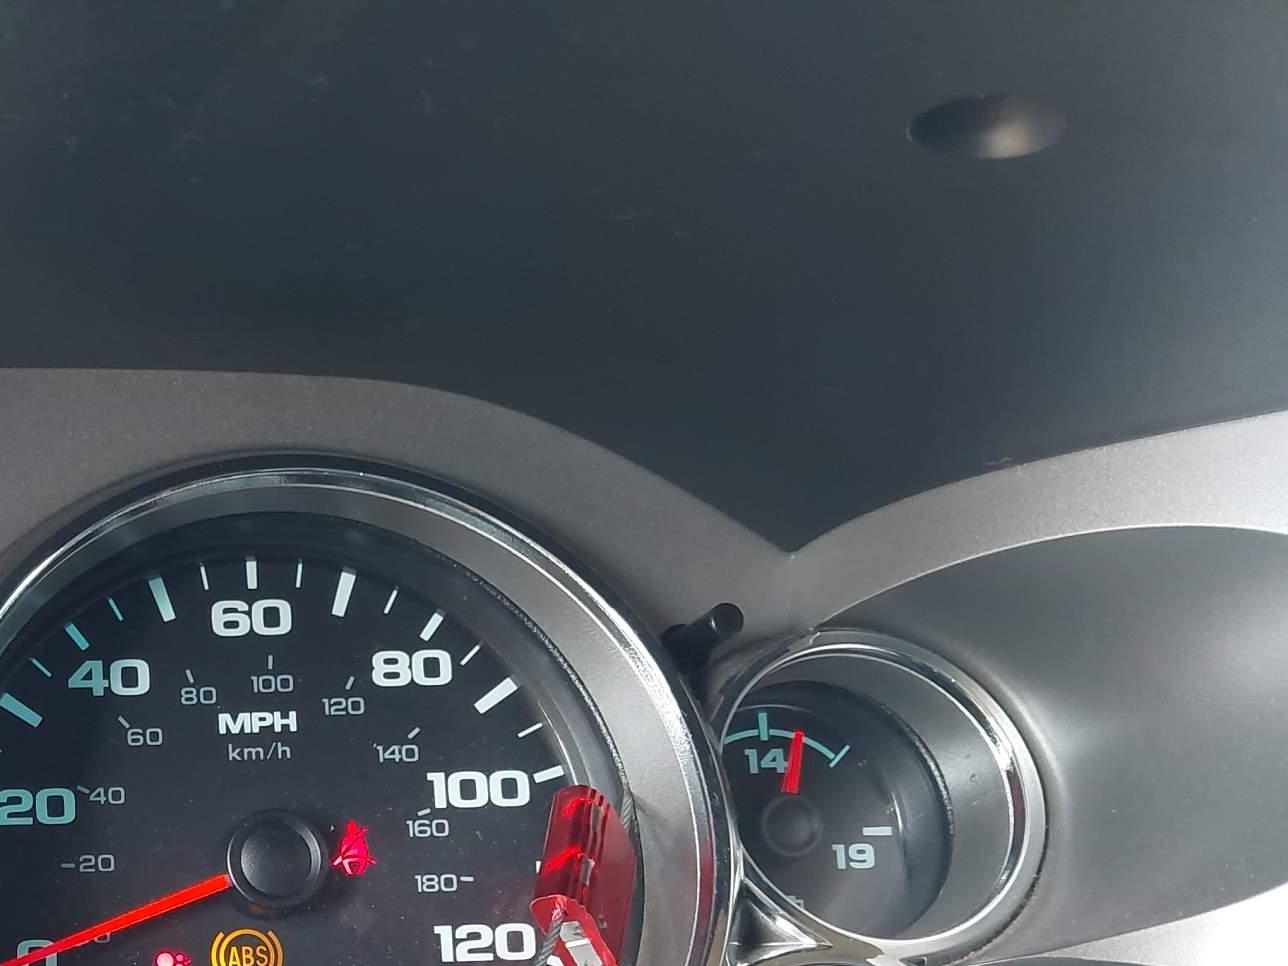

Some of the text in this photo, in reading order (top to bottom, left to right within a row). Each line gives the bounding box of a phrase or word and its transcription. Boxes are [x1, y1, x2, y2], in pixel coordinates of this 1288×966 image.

[211, 598, 293, 637] 60
[67, 658, 151, 697] 40
[371, 649, 453, 687] 80
[250, 674, 294, 693] 100
[180, 686, 217, 705] 80
[322, 696, 366, 715] 120
[217, 710, 298, 735] MPH
[126, 727, 163, 746] 60
[227, 741, 292, 761] km/h
[375, 743, 419, 763] 140
[744, 748, 789, 775] 14
[88, 786, 126, 804] 40
[426, 768, 531, 809] 100
[405, 818, 450, 838] 160
[78, 854, 116, 873] 20
[831, 842, 876, 870] 19
[414, 873, 458, 893] 180
[433, 921, 537, 963] 120
